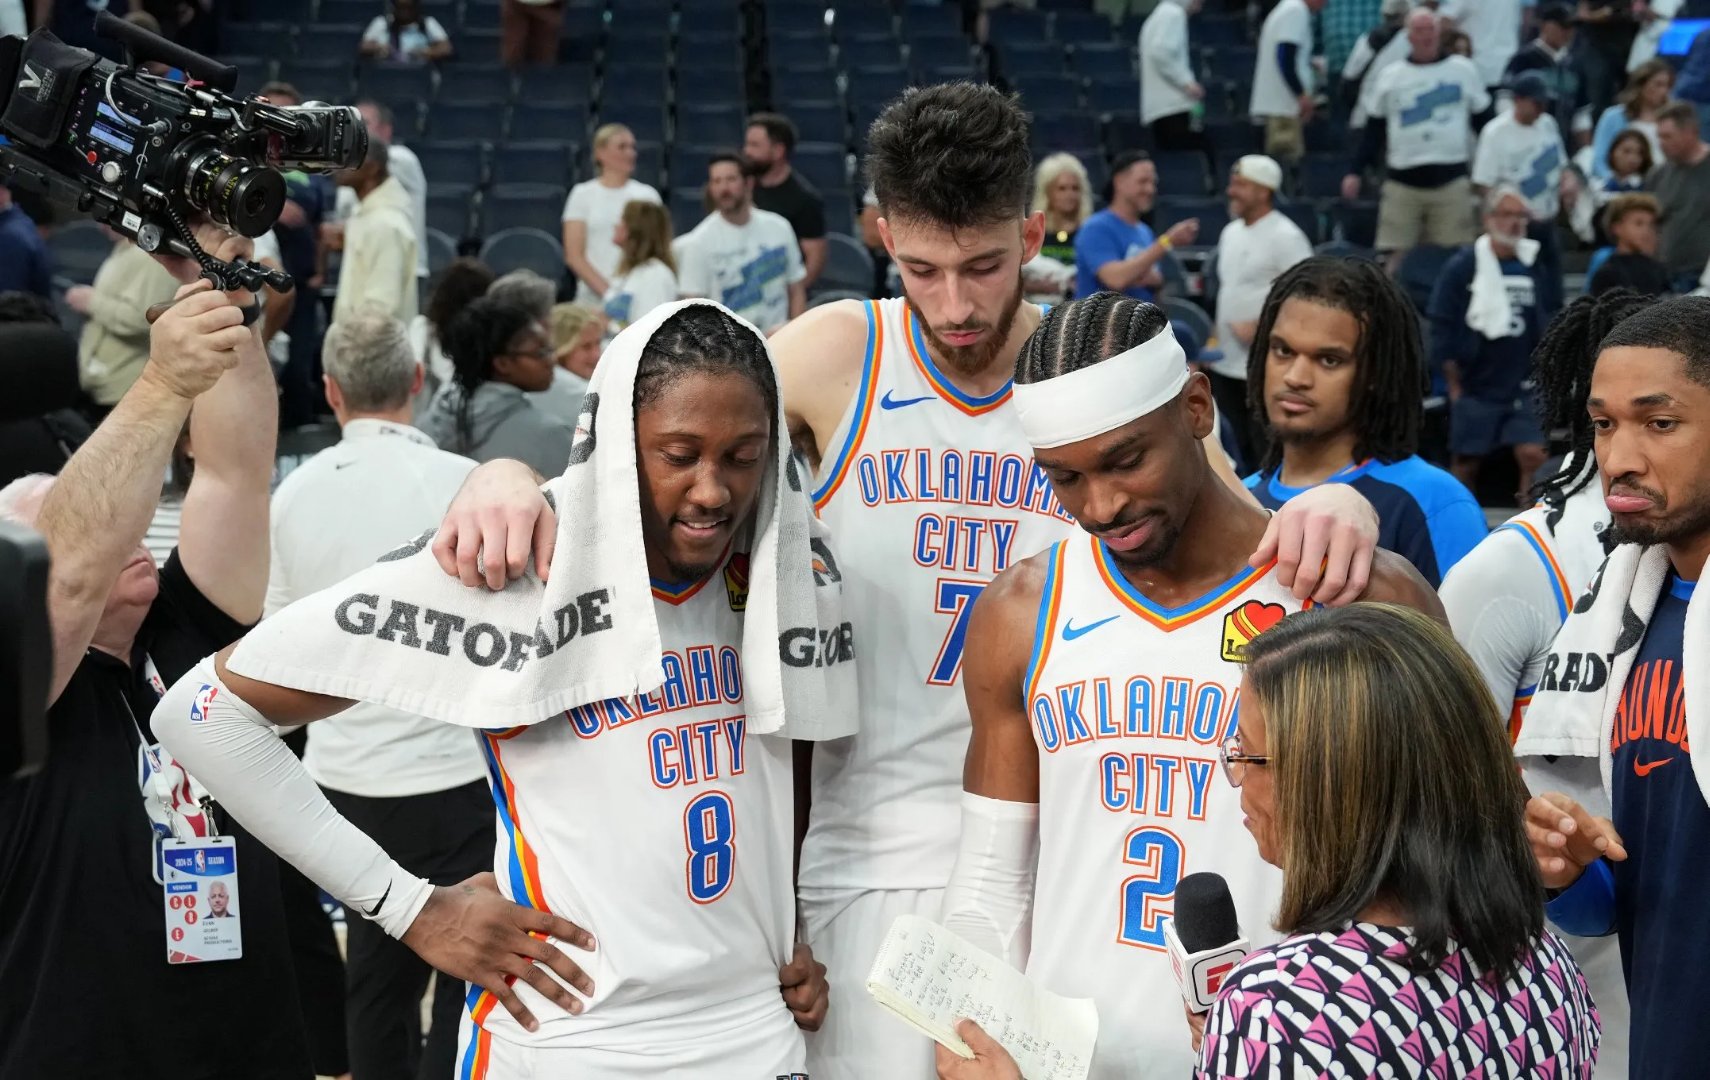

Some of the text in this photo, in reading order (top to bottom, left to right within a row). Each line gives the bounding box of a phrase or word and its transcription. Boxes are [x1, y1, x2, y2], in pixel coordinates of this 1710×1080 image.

[913, 513, 1019, 574] CITY
[926, 577, 992, 687] 7
[1539, 651, 1615, 692] RAD
[192, 712, 201, 720] NBA
[565, 644, 744, 740] OKLAHO
[1033, 674, 1240, 753] OKLAHO
[1611, 658, 1691, 755] HUND
[648, 714, 747, 790] CITY
[1099, 752, 1217, 821] CITY
[683, 789, 736, 905] 8
[1116, 825, 1186, 953] 2
